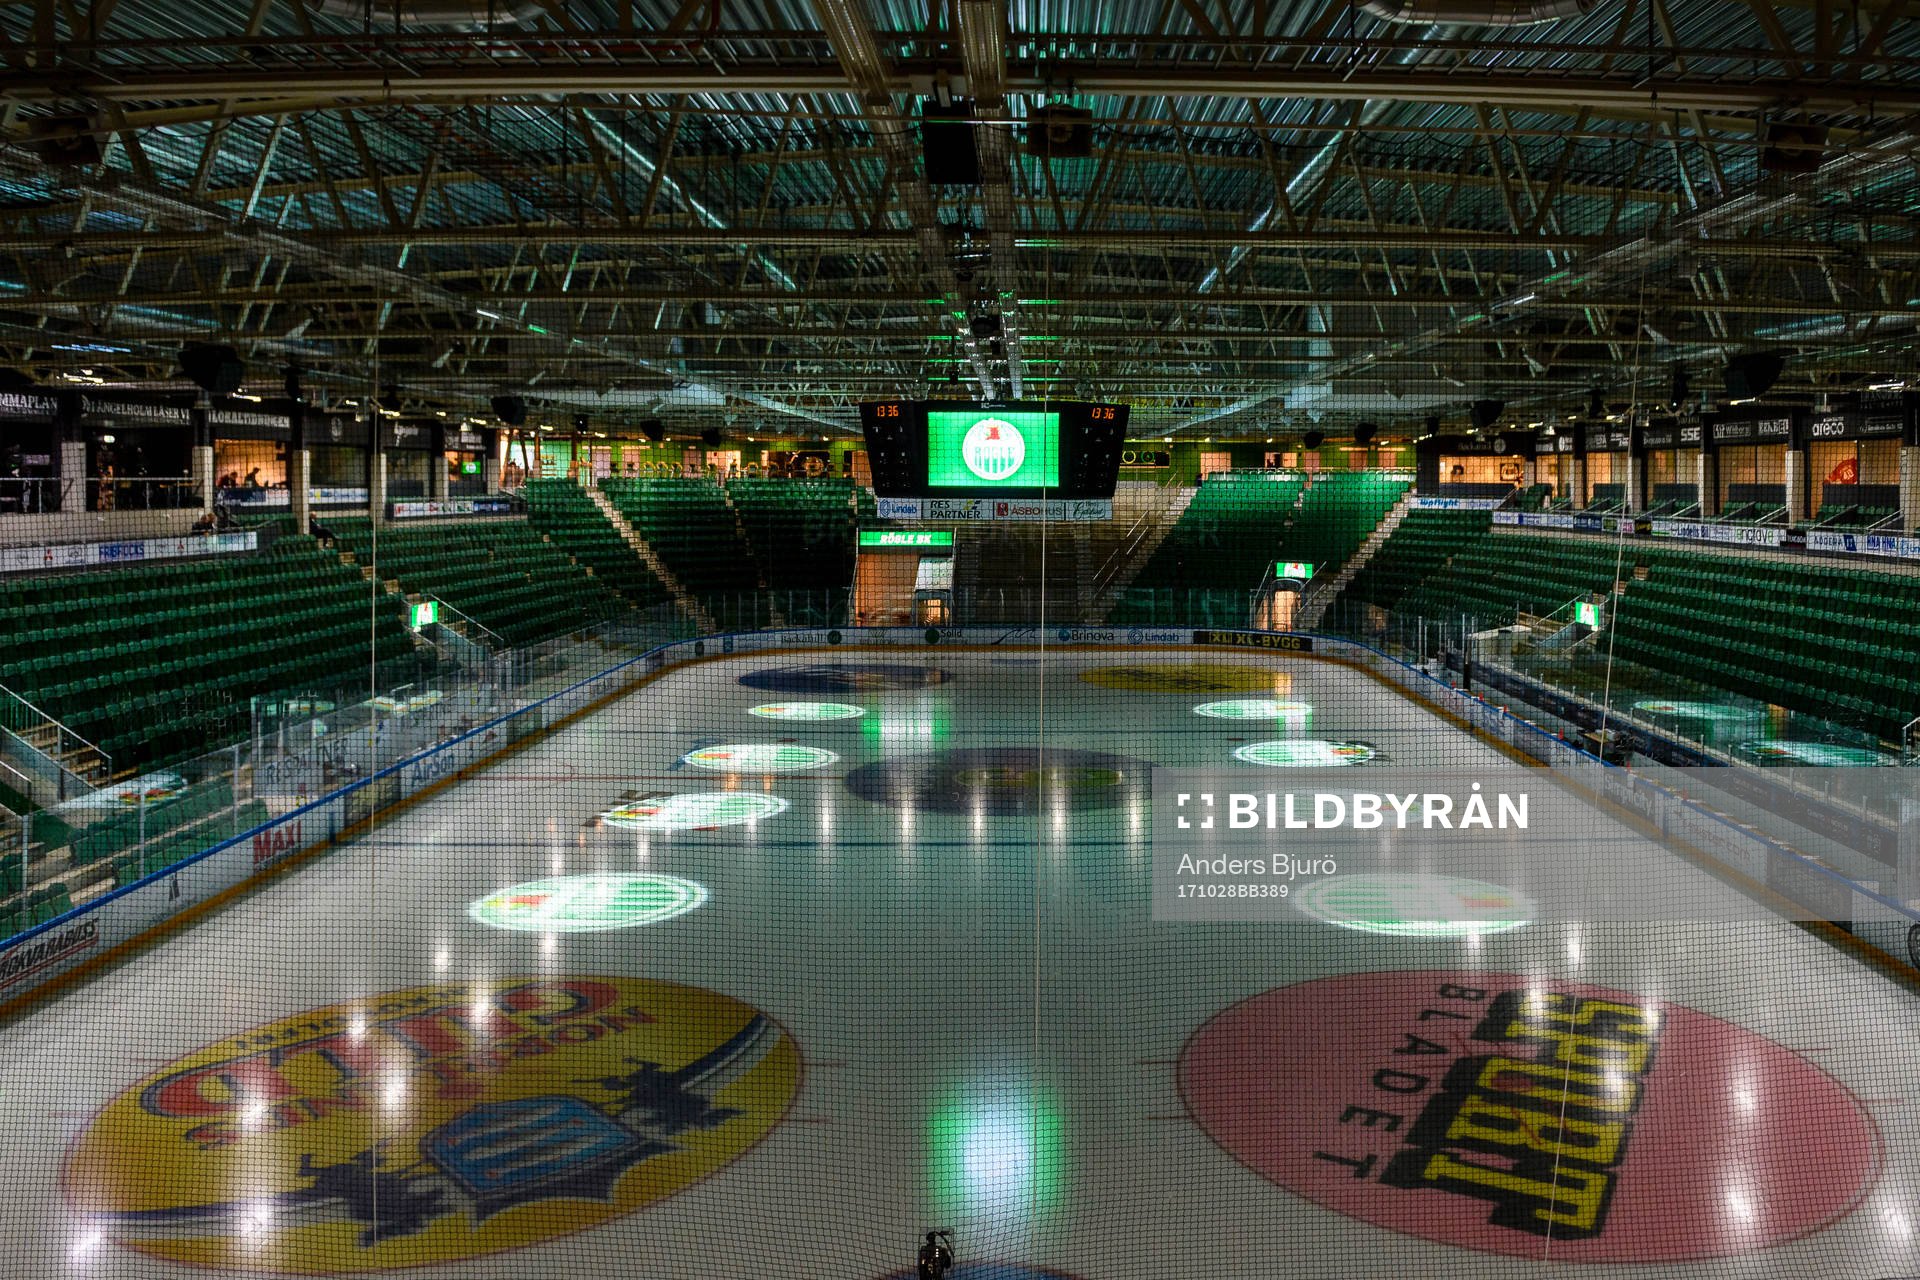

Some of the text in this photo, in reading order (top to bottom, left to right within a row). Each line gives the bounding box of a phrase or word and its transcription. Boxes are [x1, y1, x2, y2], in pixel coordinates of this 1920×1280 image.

[891, 504, 917, 514] Lindab
[930, 500, 950, 509] RES
[930, 510, 981, 519] PARTNER
[880, 532, 915, 544] RÖGLE
[940, 629, 962, 638] Solid
[1071, 630, 1115, 641] Brinova
[1145, 632, 1180, 641] Lindab
[1312, 982, 1487, 1180] BLADET
[1405, 990, 1665, 1235] SPORT
